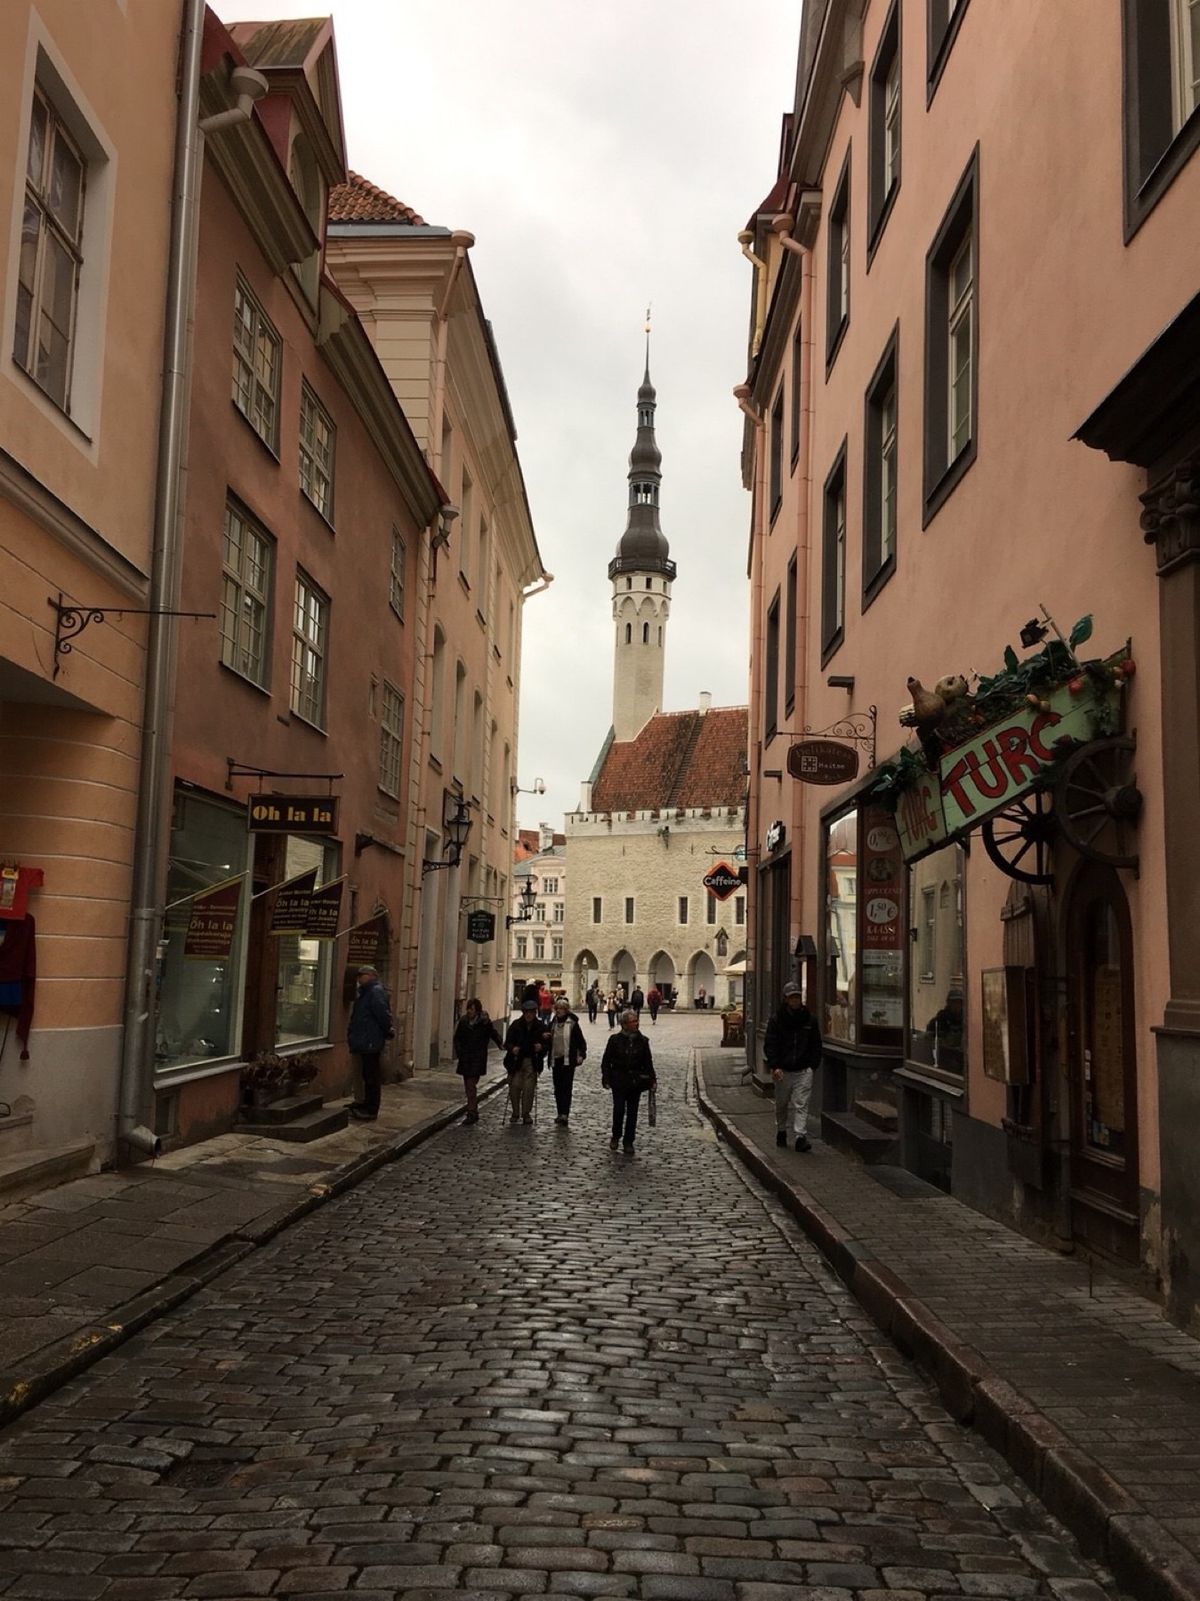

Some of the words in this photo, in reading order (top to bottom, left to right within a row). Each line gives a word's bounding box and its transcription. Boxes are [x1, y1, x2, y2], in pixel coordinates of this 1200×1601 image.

[252, 805, 280, 821] Oh
[287, 806, 306, 822] la
[312, 807, 332, 822] la
[704, 875, 742, 887] Caffeine
[207, 919, 219, 930] la
[222, 921, 233, 931] la
